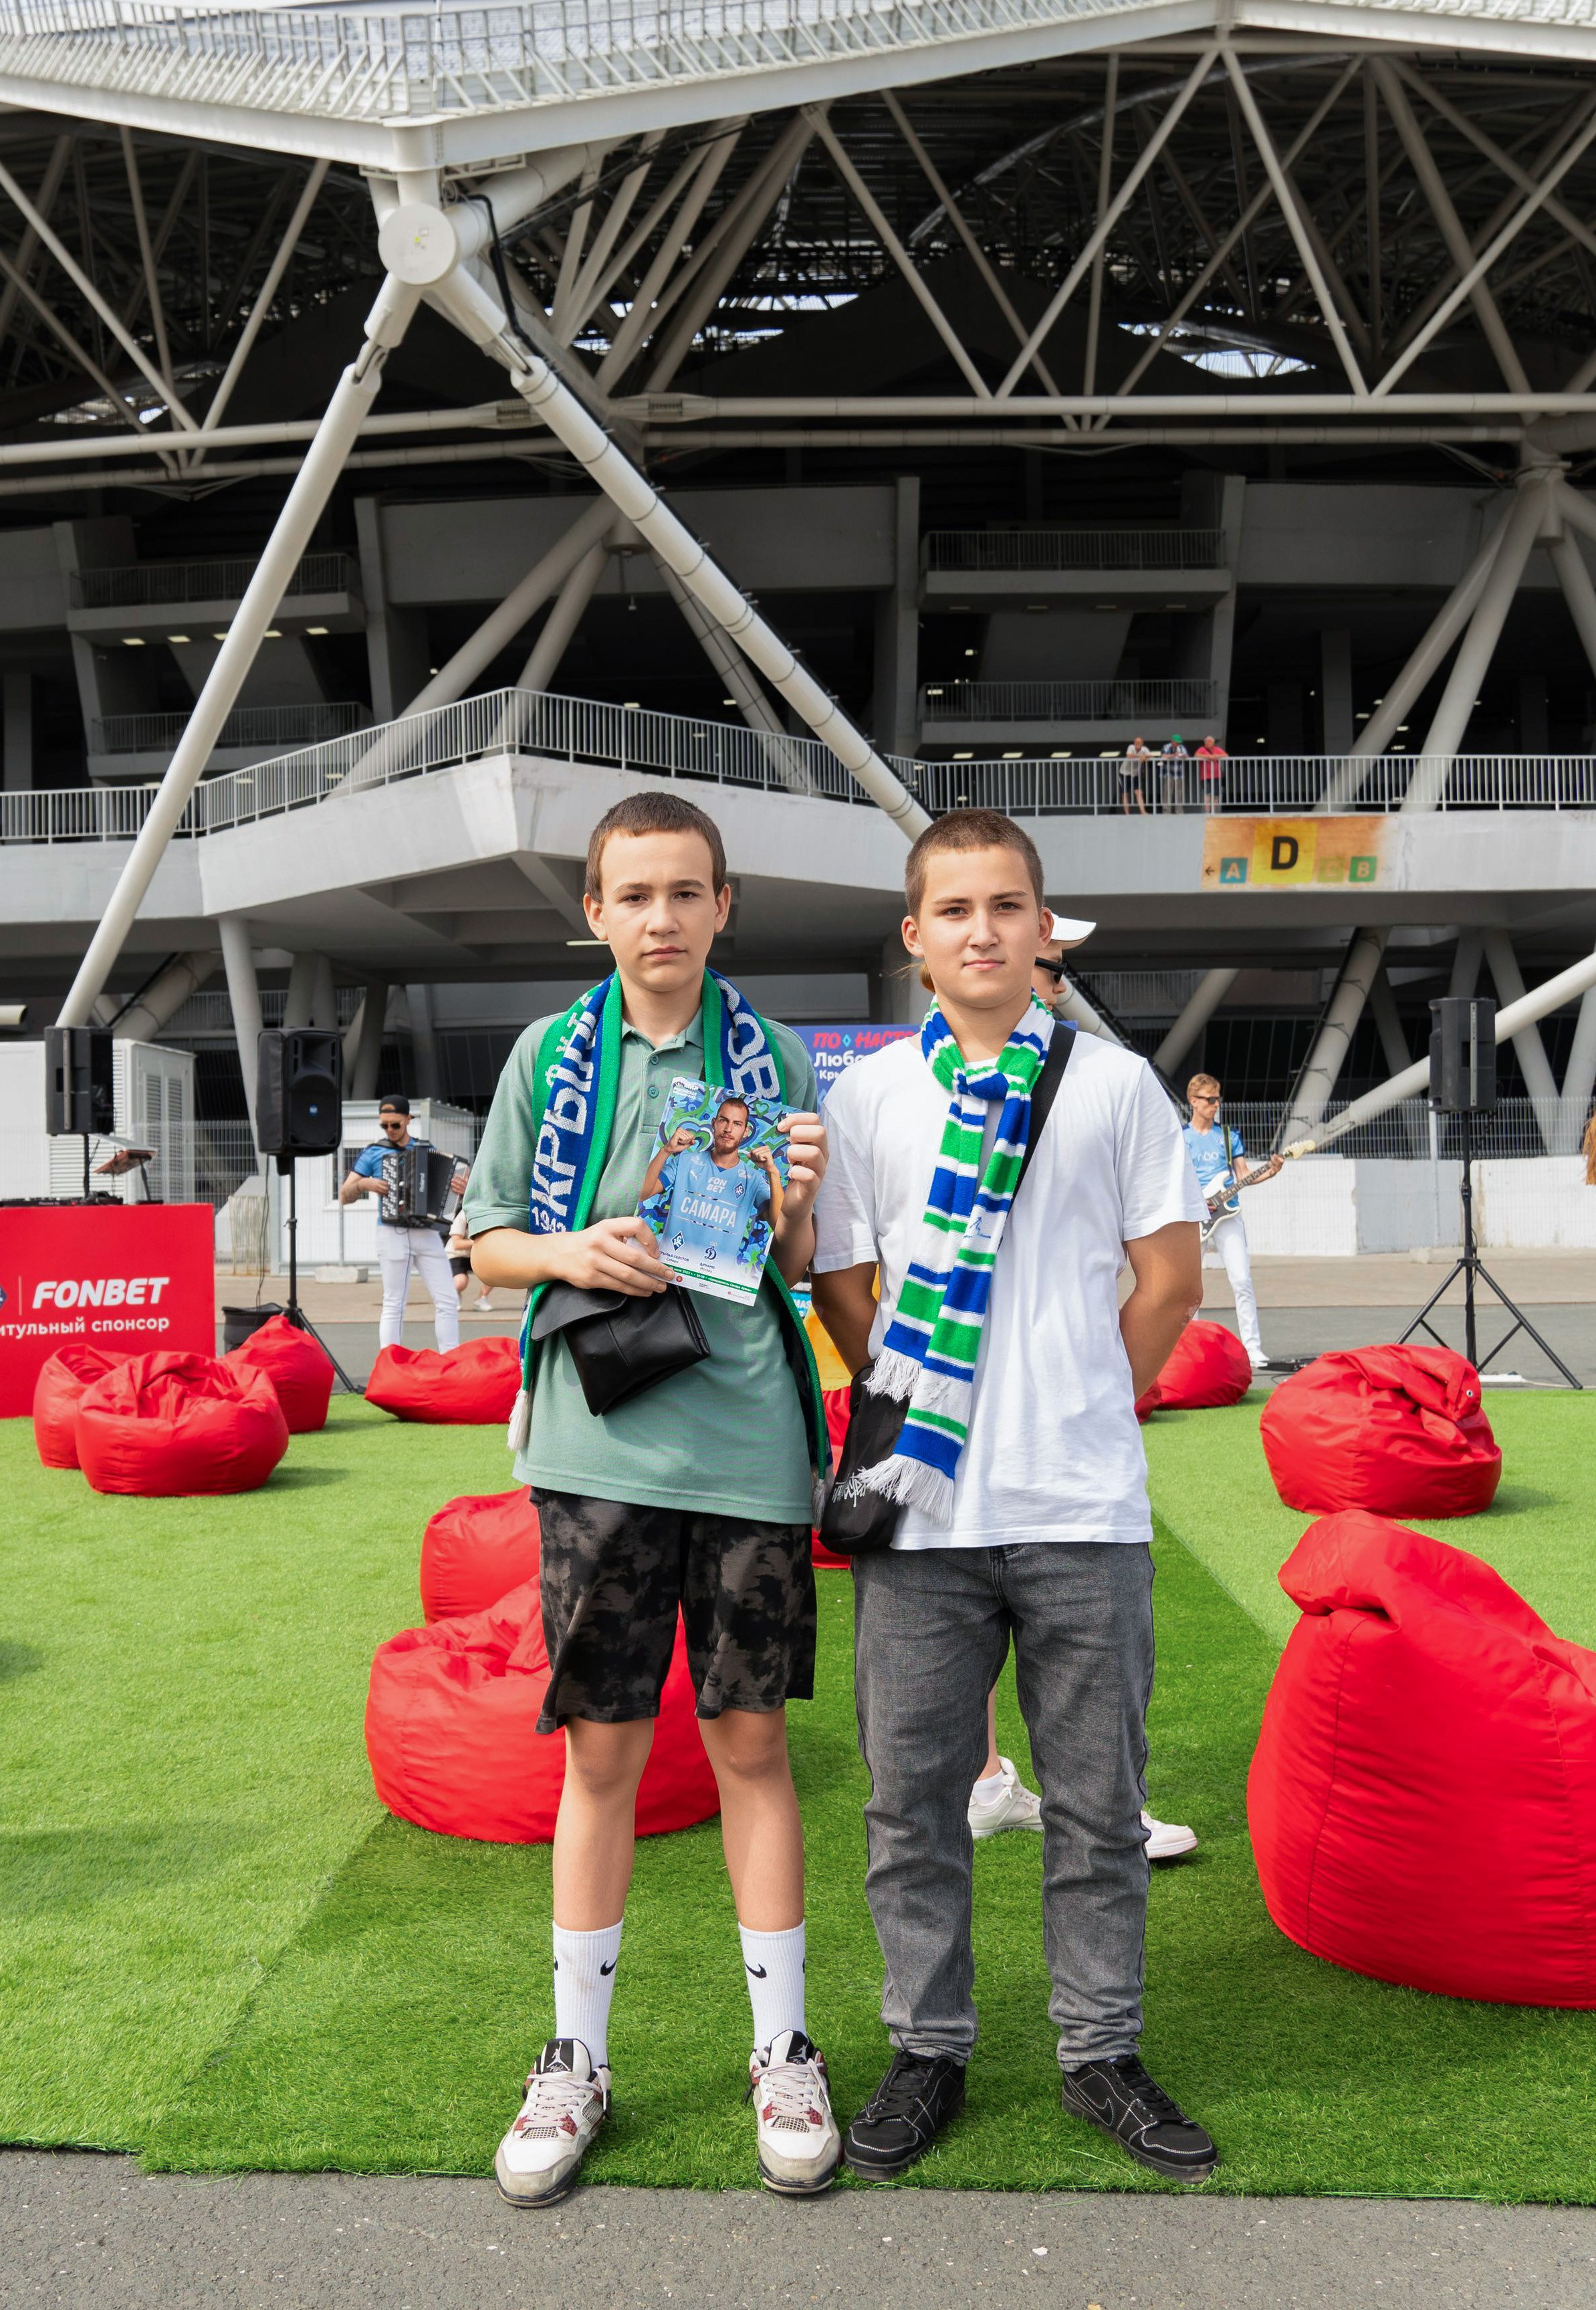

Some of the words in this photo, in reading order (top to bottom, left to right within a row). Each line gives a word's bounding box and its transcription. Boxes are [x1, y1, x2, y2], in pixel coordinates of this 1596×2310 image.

[1271, 835, 1298, 869] D
[1226, 863, 1240, 879] A
[1357, 861, 1369, 877] B
[813, 1032, 841, 1049] ПО
[706, 1184, 725, 1194] BET
[707, 1177, 727, 1186] FON
[680, 1196, 737, 1228] САМАРА
[32, 1277, 170, 1309] FONBET
[92, 1317, 170, 1332] спонсор
